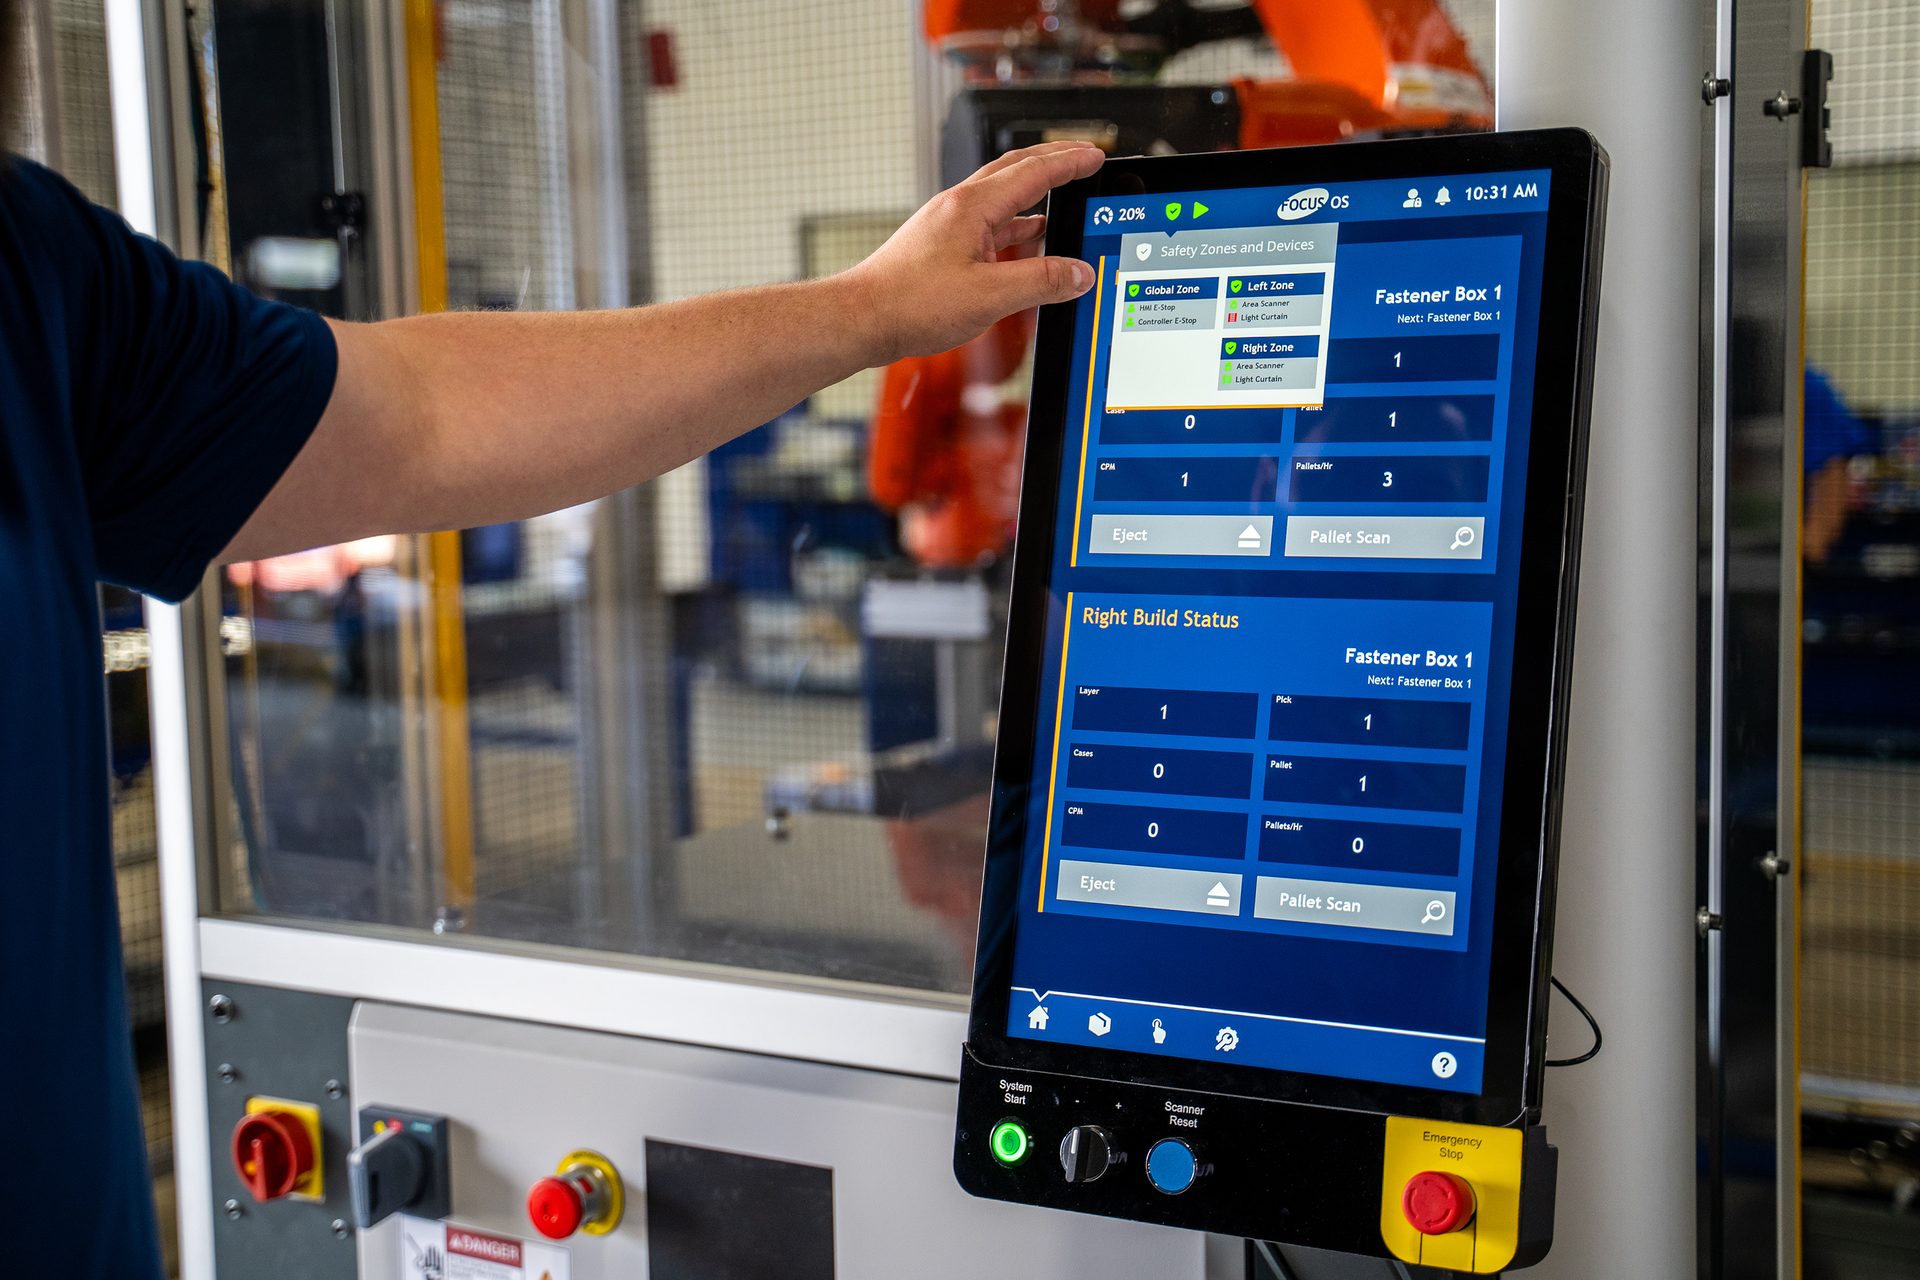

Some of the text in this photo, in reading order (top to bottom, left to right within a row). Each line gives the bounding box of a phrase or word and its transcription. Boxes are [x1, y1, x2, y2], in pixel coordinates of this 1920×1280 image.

[1466, 183, 1538, 201] 10:31 AM
[1281, 195, 1349, 212] FOCUS OS
[1119, 208, 1145, 221] 20%
[1161, 240, 1314, 258] Safety Zones and Devices
[1145, 284, 1200, 295] Global Zone
[1248, 281, 1294, 291] Left Zone
[1375, 284, 1501, 305] Fastener Box 1
[1154, 304, 1175, 312] E-Stop
[1175, 317, 1197, 325] E-Stop
[1241, 314, 1258, 322] Light
[1397, 310, 1501, 324] Next: Fastener Box 1
[1242, 343, 1294, 354] Right Zone
[1394, 352, 1401, 367] 1
[1235, 376, 1253, 384] Light
[1184, 415, 1196, 430] 0
[1389, 411, 1396, 428] 1
[1296, 462, 1333, 471] Pallets/Hr
[1181, 472, 1189, 487] 1
[1382, 472, 1393, 487] 3
[1113, 528, 1148, 543] Eject
[1310, 530, 1390, 544] Pallet Scan
[1083, 607, 1239, 628] Right Build Status
[1345, 648, 1472, 668] Fastener Box 1
[1368, 675, 1471, 688] Next: Fastener Box 1
[1079, 687, 1099, 696] Layer
[1276, 695, 1292, 704] Pick
[1160, 704, 1168, 719] 1
[1364, 714, 1372, 730] 1
[1074, 749, 1093, 758] Cases
[1153, 763, 1164, 778] 0
[1270, 761, 1292, 769] Pallet
[1359, 775, 1367, 792] 1
[1148, 822, 1159, 838] 0
[1265, 821, 1303, 831] Pallets/Hr
[1352, 837, 1364, 853] 0
[1080, 876, 1116, 891] Eject
[1280, 892, 1361, 913] Pallet Scan
[1439, 1057, 1450, 1072] ?
[999, 1079, 1032, 1094] System
[1004, 1092, 1026, 1105] Start
[1165, 1101, 1205, 1116] Scanner
[1170, 1115, 1198, 1128] Reset
[1422, 1131, 1482, 1149] Emergency
[1439, 1147, 1464, 1161] Stop
[462, 1234, 520, 1260] DANGER
